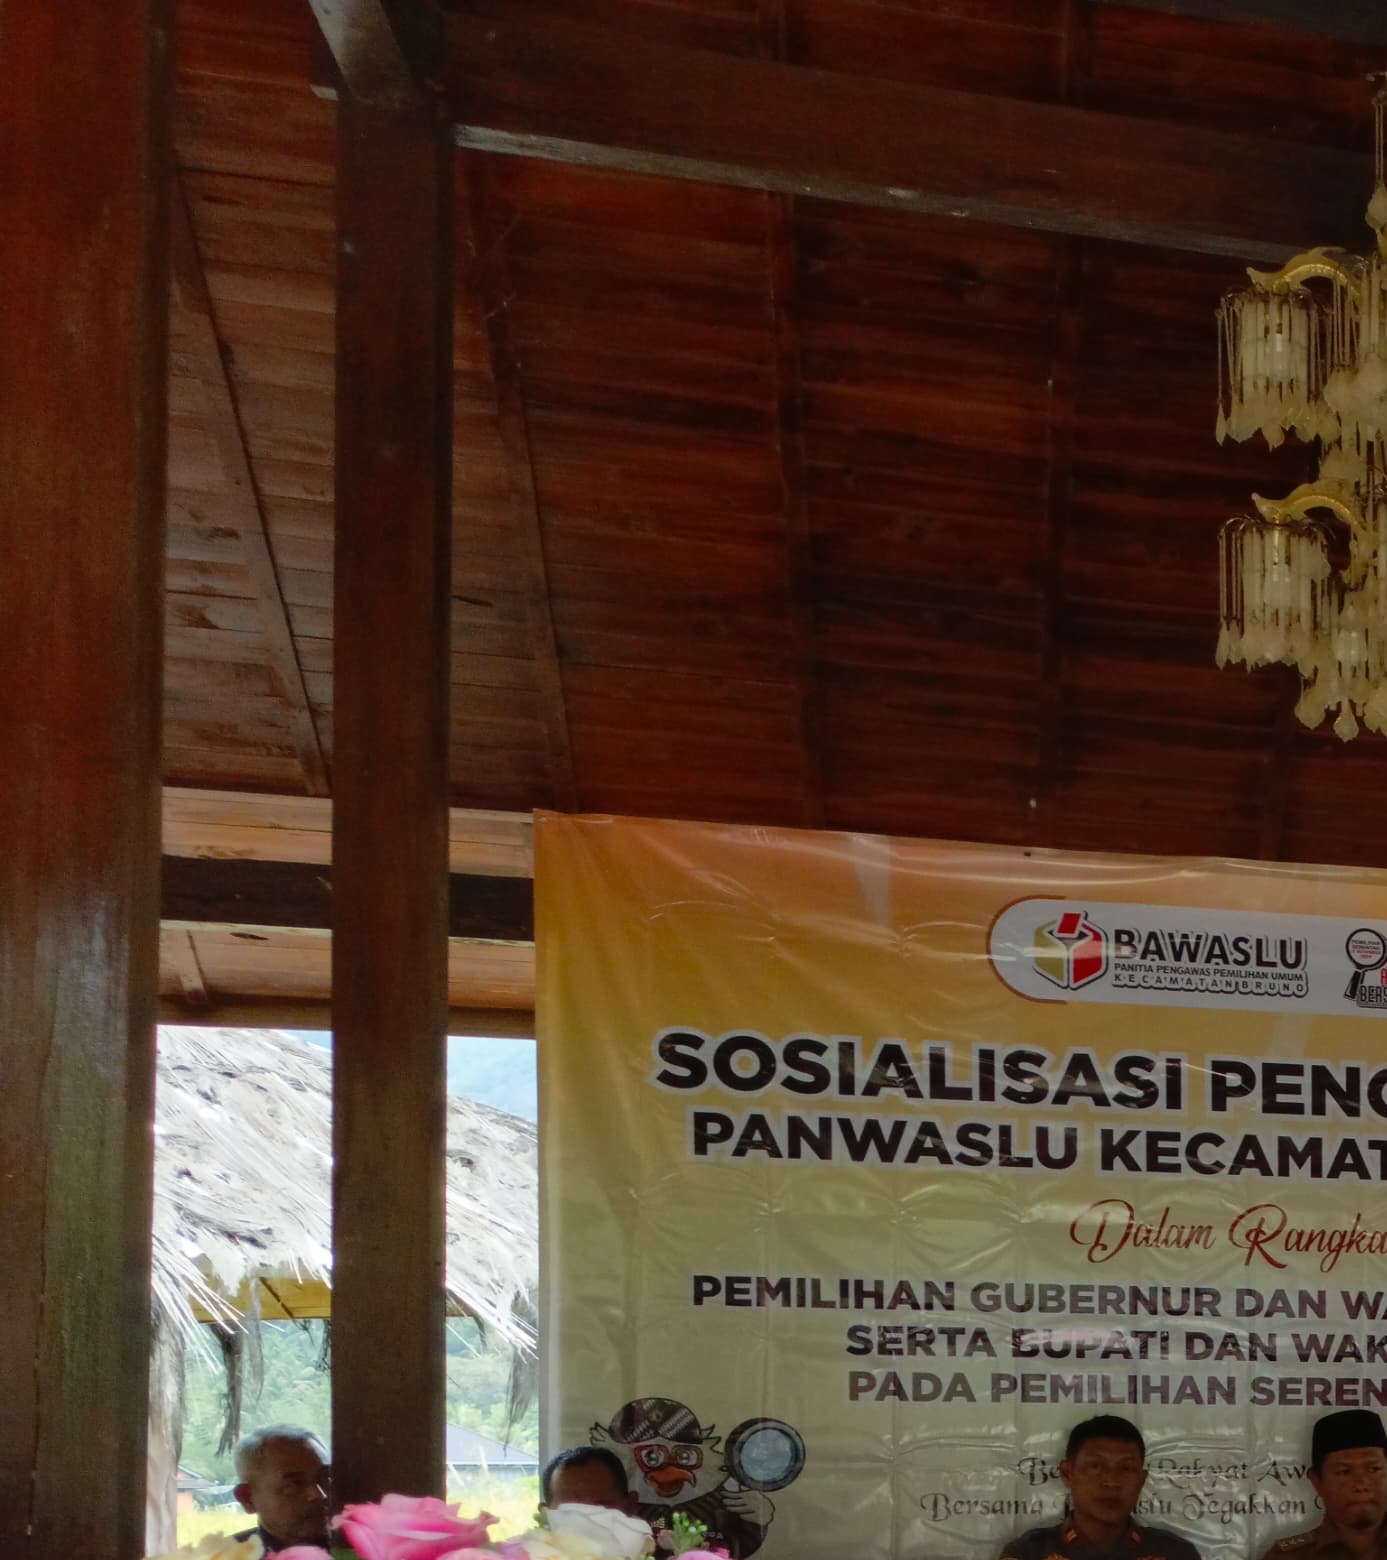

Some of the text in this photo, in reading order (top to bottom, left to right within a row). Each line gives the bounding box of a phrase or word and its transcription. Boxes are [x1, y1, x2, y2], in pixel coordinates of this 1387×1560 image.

[1113, 928, 1304, 970] BAWASLU
[1114, 962, 1304, 982] PANITIA PENGAWAS PEMILIHAN UMUM
[1242, 980, 1305, 992] BRUNO
[656, 1031, 1182, 1111] SOSIALISASI
[692, 1111, 1078, 1170] PANWASLU
[1069, 1198, 1215, 1264] Dalam
[692, 1274, 956, 1311] PEMILIHAN
[970, 1281, 1221, 1318] GUBERNUR
[1235, 1288, 1327, 1320] DAN
[846, 1325, 998, 1358] SERTA
[1011, 1327, 1170, 1361] BUPATI
[1184, 1331, 1277, 1363] DAN
[848, 1371, 977, 1403] PADA
[990, 1373, 1237, 1406] PEMILIHAN
[919, 1492, 1043, 1521] Bersama
